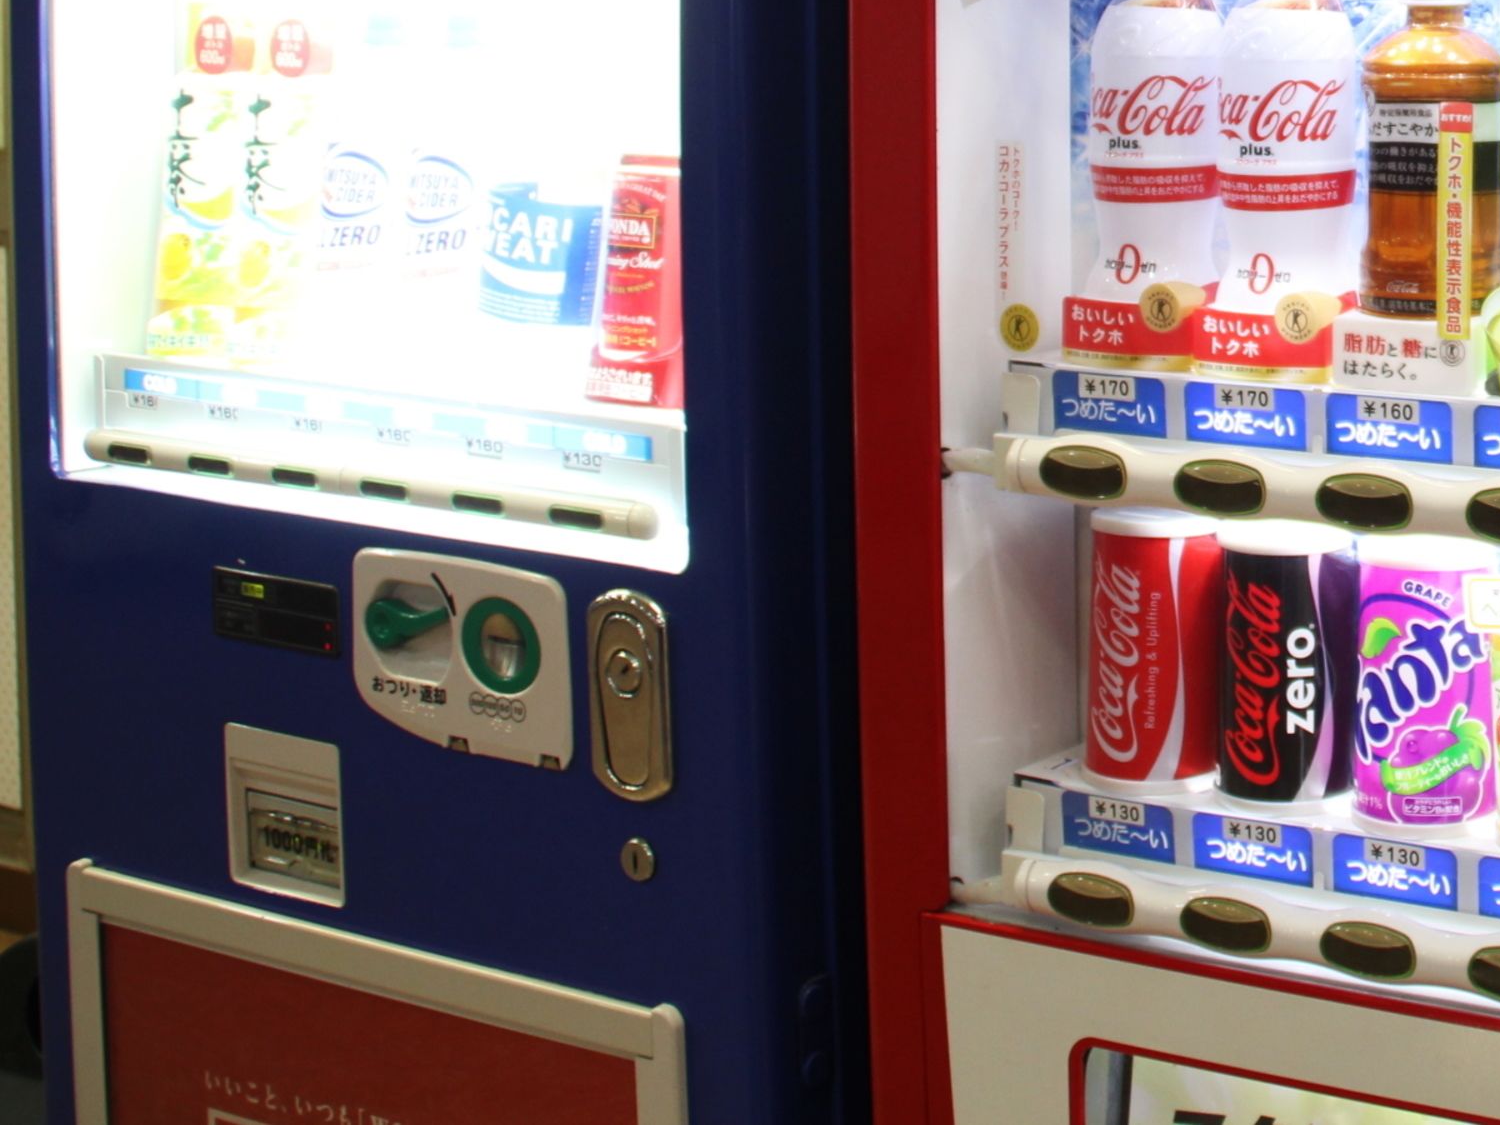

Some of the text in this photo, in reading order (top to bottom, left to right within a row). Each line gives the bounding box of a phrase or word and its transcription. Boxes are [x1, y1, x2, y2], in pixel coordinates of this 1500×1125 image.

[1108, 137, 1141, 151] plus
[1239, 143, 1273, 158] plus
[329, 224, 381, 249] ZERO
[415, 228, 467, 256] ZERO
[1446, 137, 1463, 334] トクホ・機能性表示食品
[1071, 304, 1134, 325] おいしい
[1078, 325, 1125, 345] トクホ
[1203, 315, 1271, 338] おいしい
[1210, 337, 1260, 358] トクホ
[1342, 331, 1438, 360] 脂肪と糖に
[1343, 360, 1420, 383] はたらく。
[1084, 379, 1130, 398] ¥170
[1220, 389, 1269, 408] ¥170
[466, 437, 504, 453] ¥160
[562, 452, 602, 468] ¥130
[1403, 580, 1452, 608] GRAPE
[1144, 591, 1161, 729] Refreshing & Uplifting
[1225, 569, 1281, 786] Coca-Cola
[1286, 627, 1316, 735] zero
[372, 676, 447, 706] おつり・返却
[1095, 804, 1139, 822] ¥130
[1230, 824, 1277, 843] ¥130
[1371, 846, 1420, 867] ¥130
